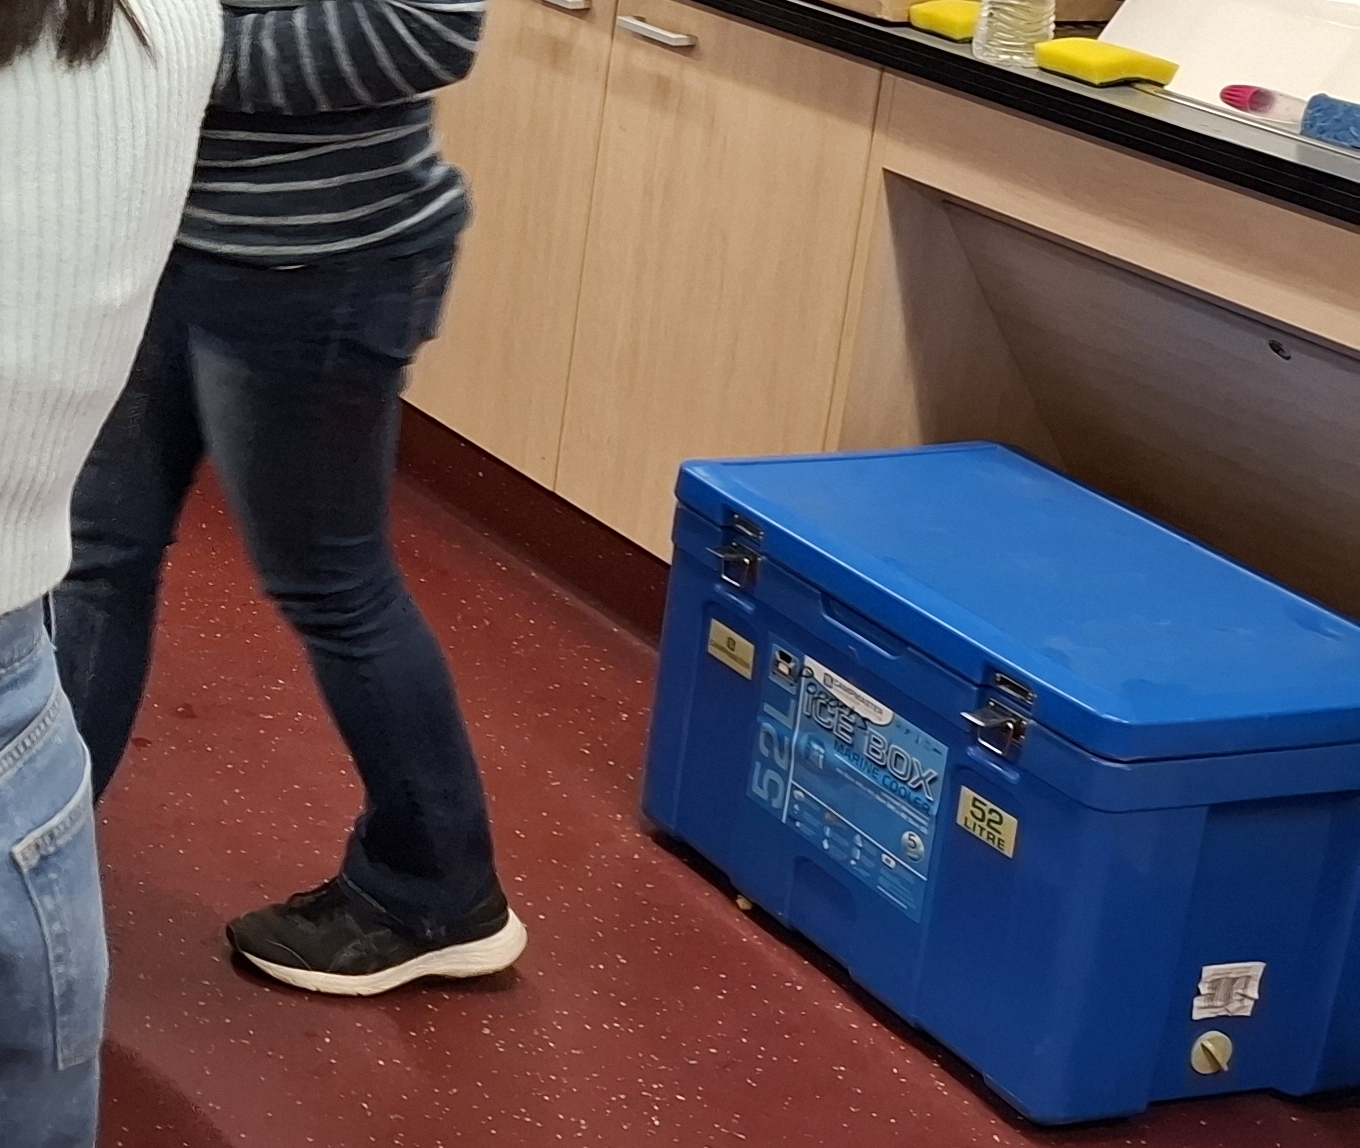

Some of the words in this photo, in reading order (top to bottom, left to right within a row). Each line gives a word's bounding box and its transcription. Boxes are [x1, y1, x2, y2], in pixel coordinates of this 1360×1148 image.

[802, 694, 858, 745] ICE
[833, 740, 881, 780] MARINE
[881, 774, 931, 815] COOLER
[863, 726, 939, 802] BOX
[963, 818, 1006, 852] LITRE
[970, 796, 1004, 836] 52
